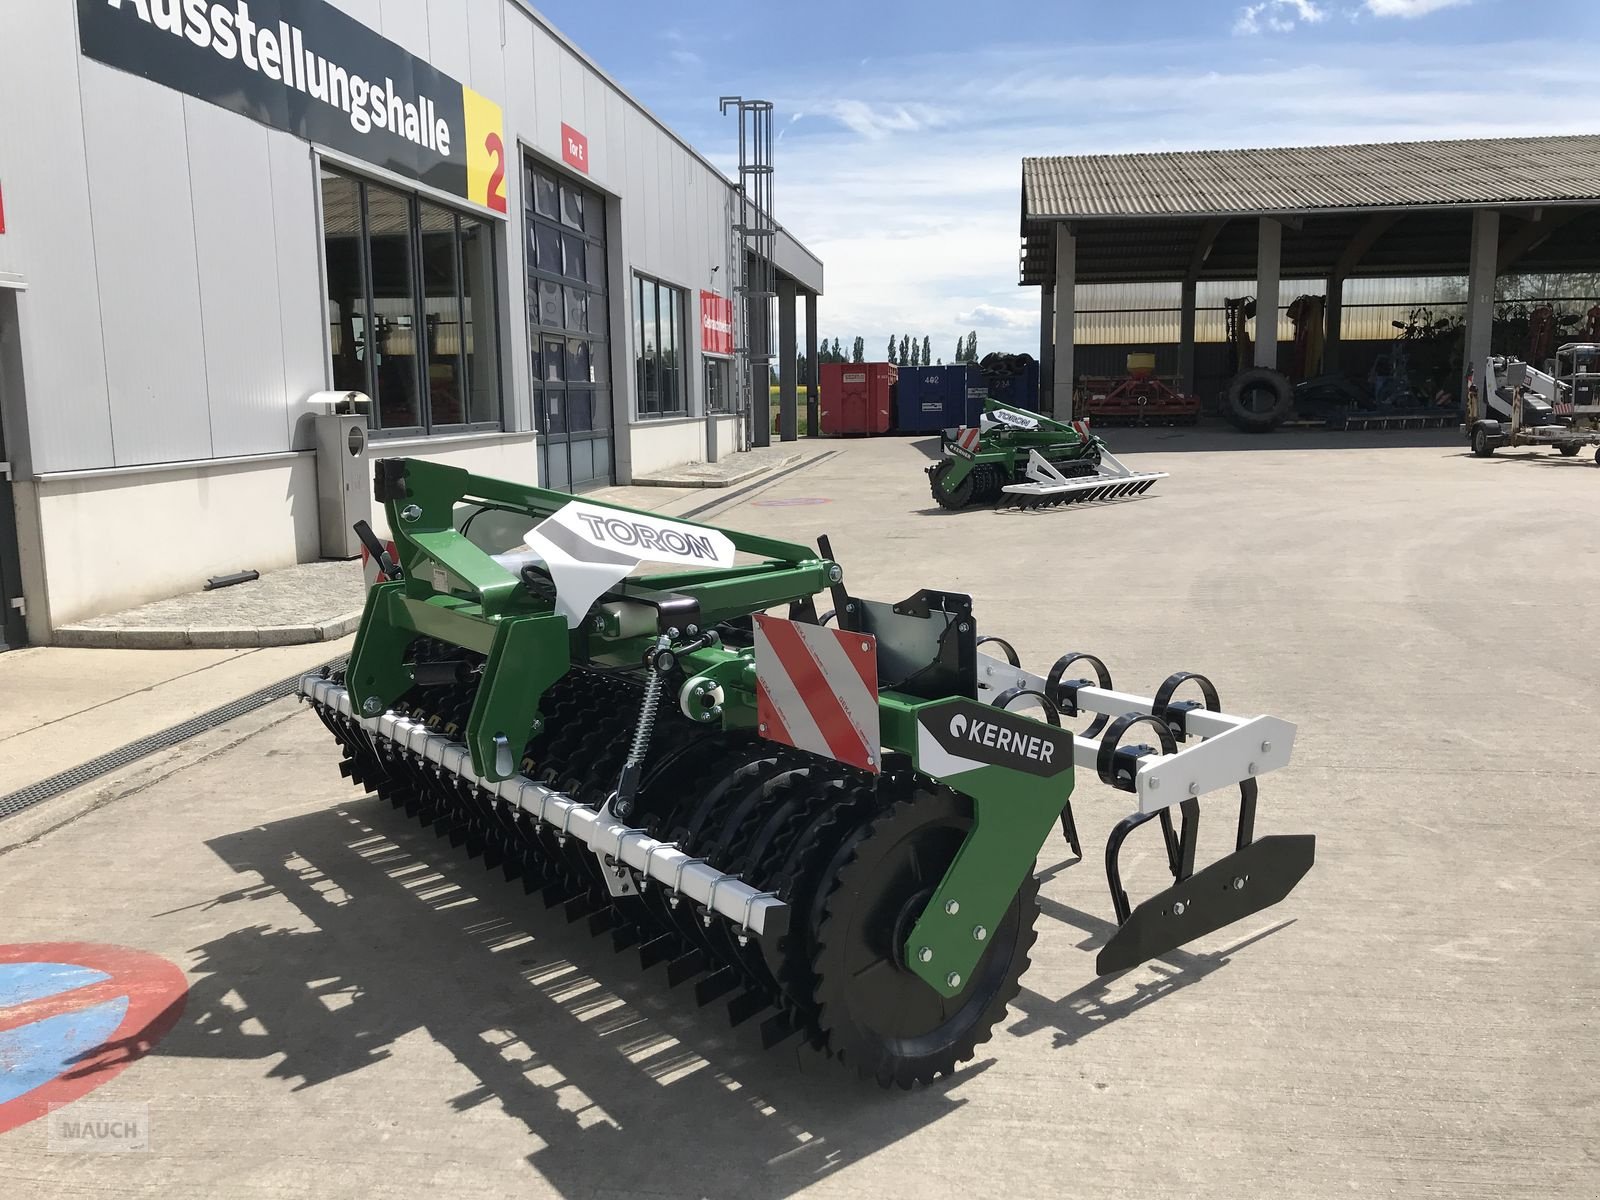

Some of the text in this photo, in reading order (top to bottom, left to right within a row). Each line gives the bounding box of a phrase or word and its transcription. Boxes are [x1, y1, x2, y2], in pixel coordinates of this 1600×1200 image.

[108, 0, 507, 214] usstellungshalle 2
[568, 138, 583, 160] Tor E
[998, 411, 1031, 427] TORON
[576, 512, 719, 562] TORON
[838, 695, 852, 716] GEKA
[968, 719, 1055, 764] KERNER
